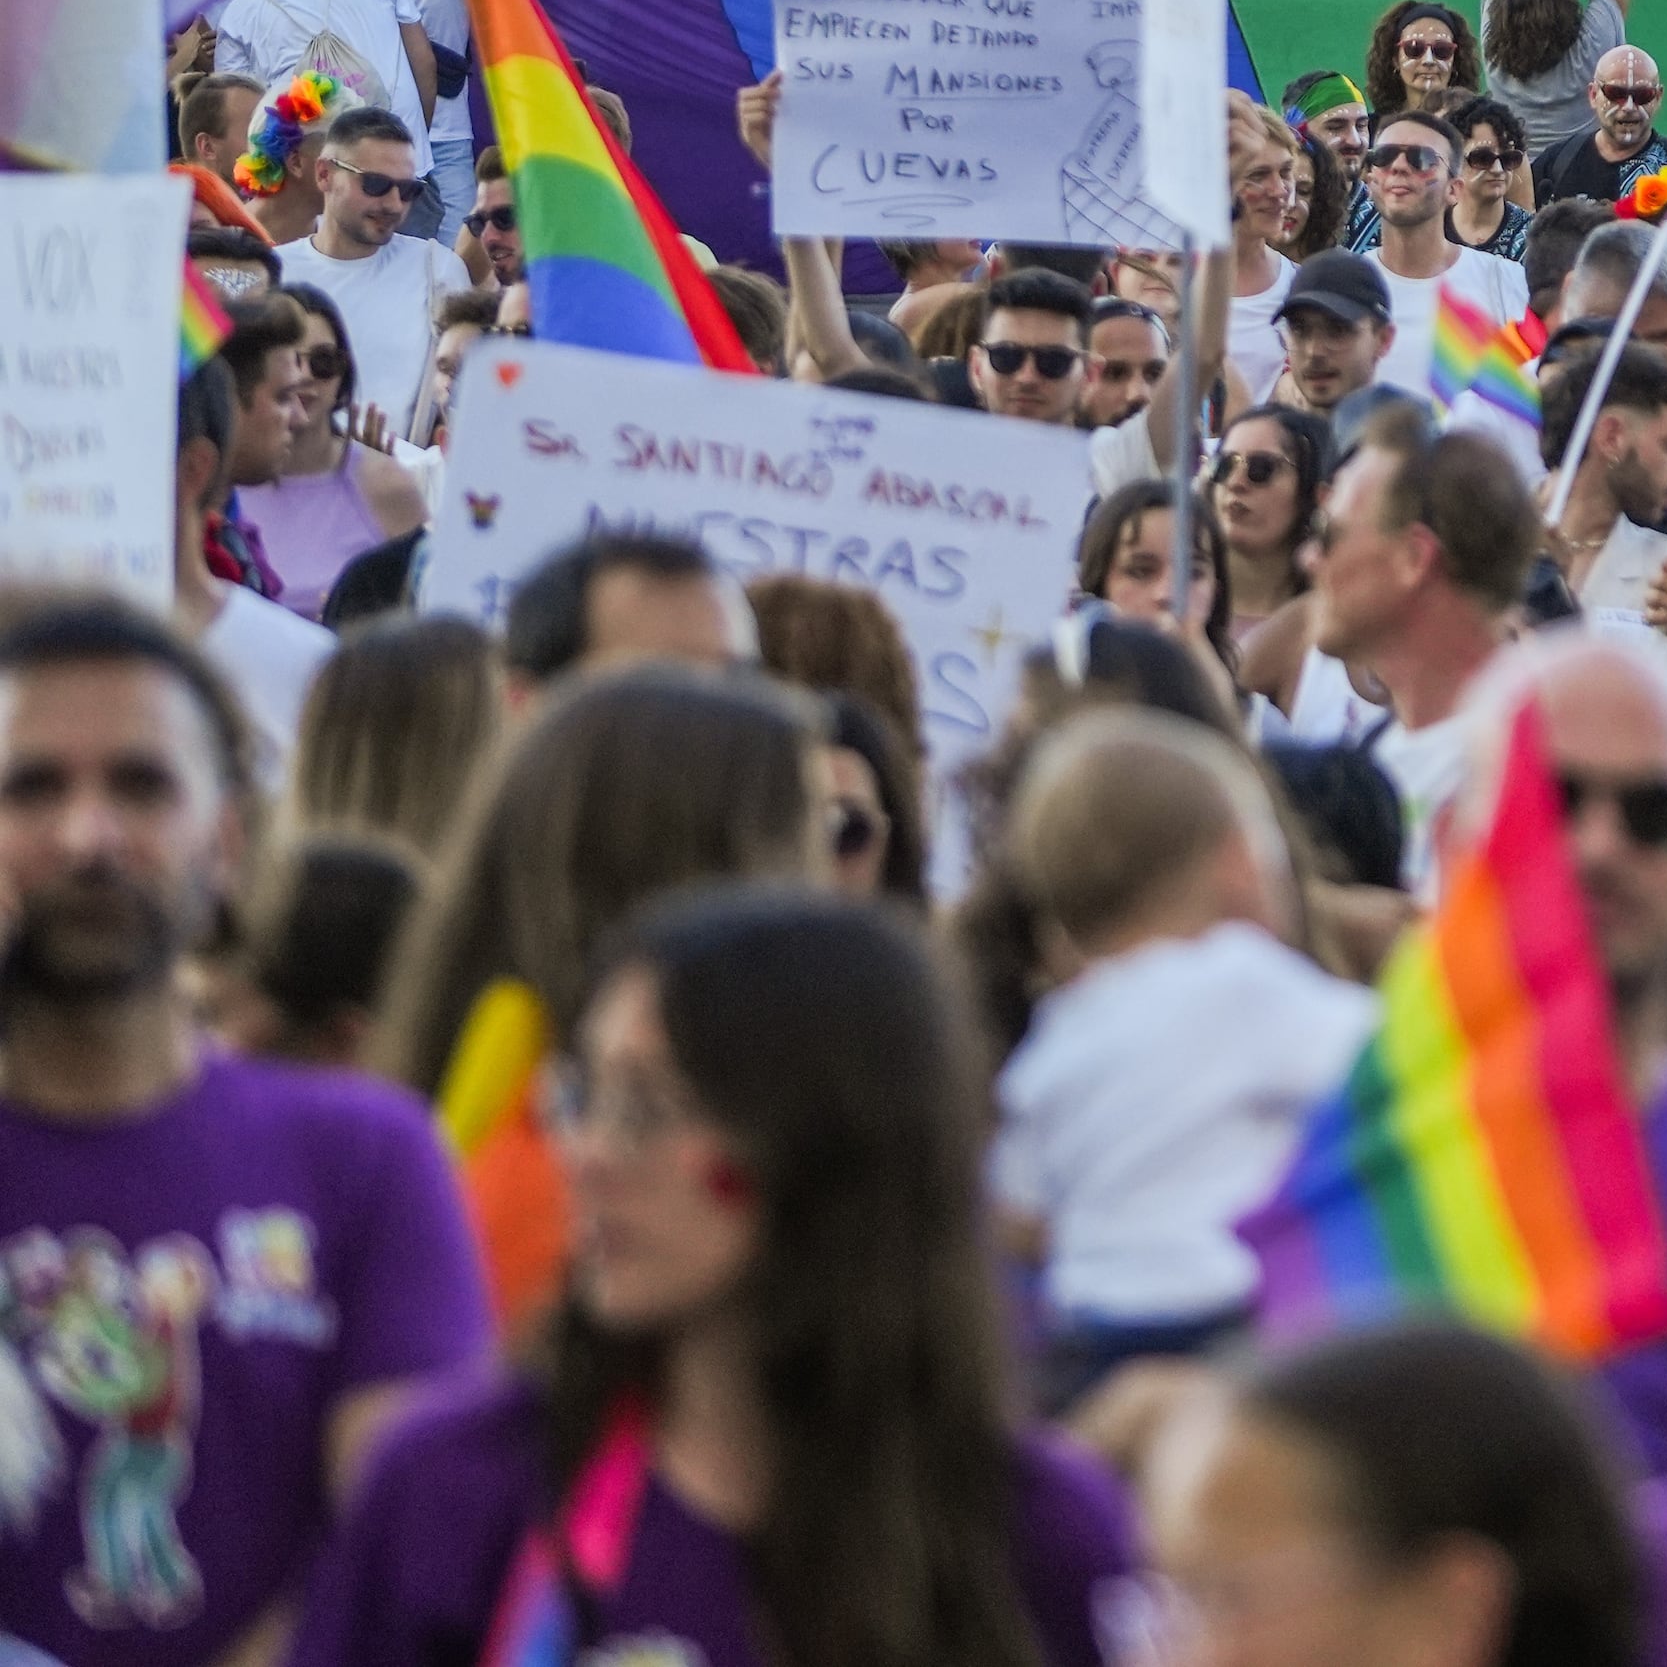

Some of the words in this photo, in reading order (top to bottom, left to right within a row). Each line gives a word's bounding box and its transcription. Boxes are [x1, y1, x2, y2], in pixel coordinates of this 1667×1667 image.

[784, 6, 911, 40] EMPIECEN
[931, 19, 1040, 48] DEJANDO
[794, 55, 854, 81] SUS
[883, 62, 1064, 96] MANSIONES
[899, 107, 955, 133] POR
[811, 142, 998, 194] CUEVAS
[612, 422, 834, 500] SANTIAGO
